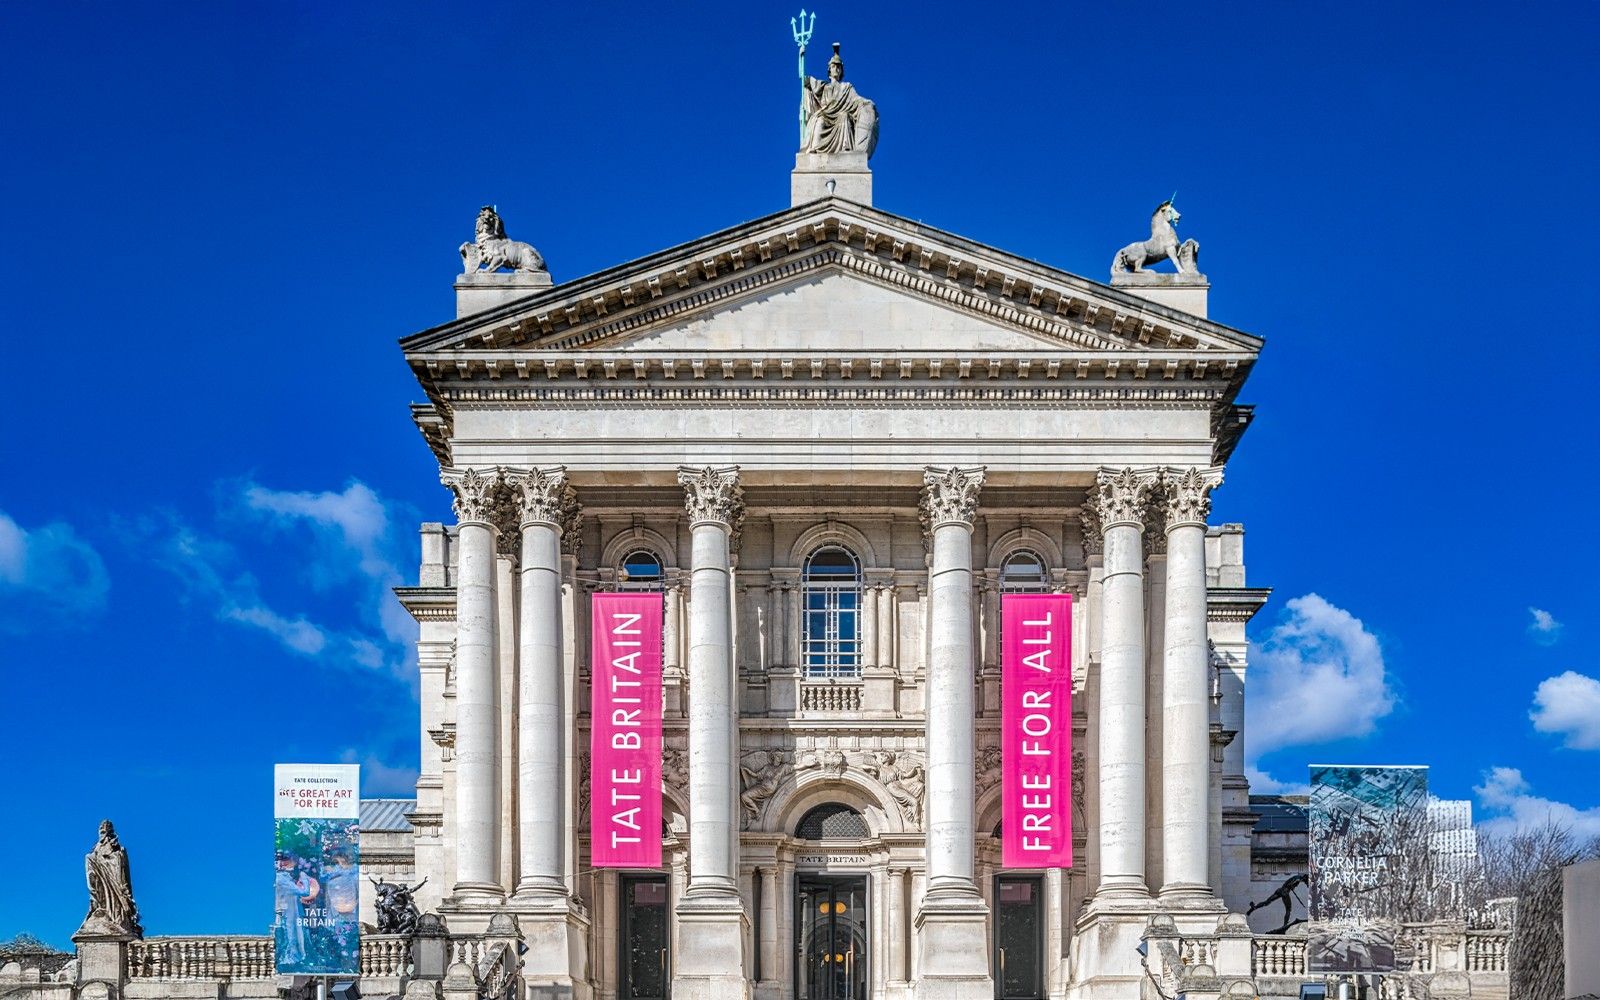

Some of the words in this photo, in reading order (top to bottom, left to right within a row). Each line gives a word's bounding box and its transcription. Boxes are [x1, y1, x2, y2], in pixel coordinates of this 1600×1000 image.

[1022, 612, 1052, 672] ALL
[611, 613, 642, 749] BRITAIN
[1022, 690, 1051, 755] FOR
[299, 789, 330, 798] GREAT
[333, 789, 353, 798] ART
[294, 799, 313, 808] FOR
[316, 799, 339, 808] FREE
[611, 769, 641, 848] TATE
[1023, 774, 1051, 850] FREE
[1316, 856, 1387, 869] CORNELIA
[1324, 871, 1379, 884] PARKER
[305, 908, 328, 917] TATE
[1340, 907, 1362, 917] TATE
[297, 918, 336, 927] BRITAIN
